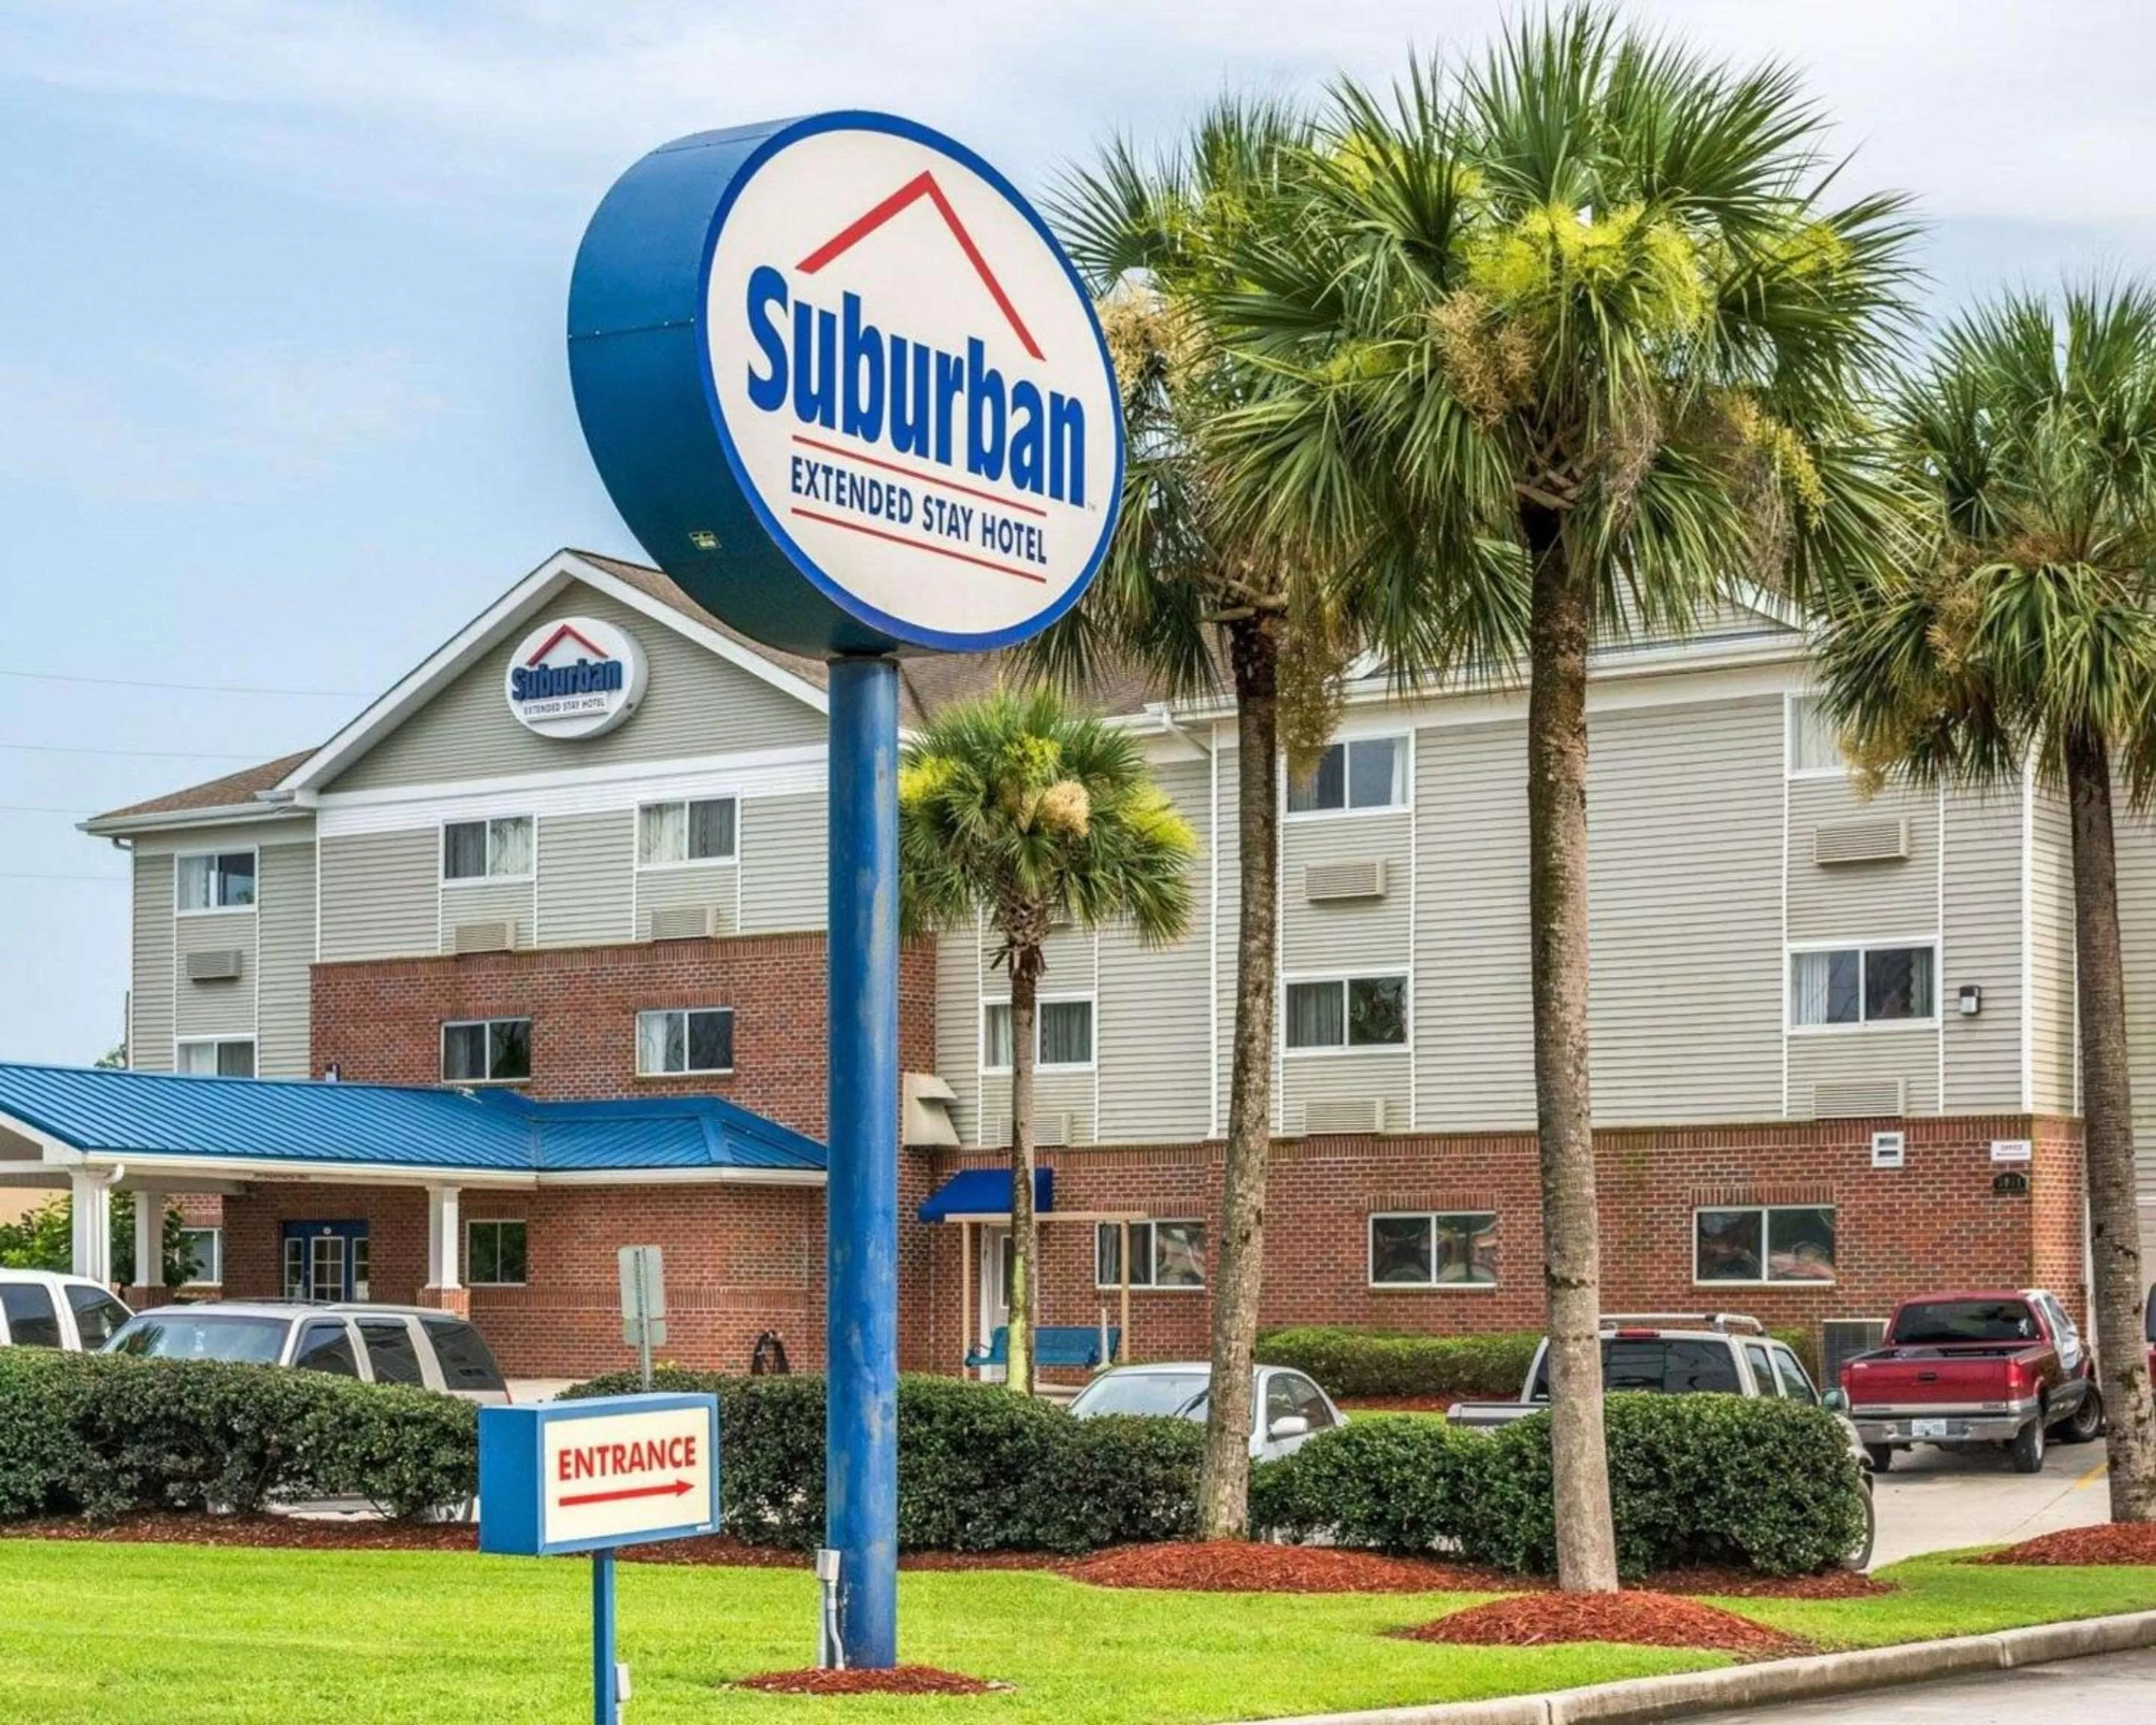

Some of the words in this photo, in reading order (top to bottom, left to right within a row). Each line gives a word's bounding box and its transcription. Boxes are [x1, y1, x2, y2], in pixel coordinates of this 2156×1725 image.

[747, 265, 1085, 508] Suburban
[791, 457, 913, 525] EXTENDED
[922, 495, 973, 542] STAY
[982, 513, 1047, 565] HOTEL
[512, 658, 622, 702] Suburban
[558, 1435, 696, 1481] ENTRANCE
